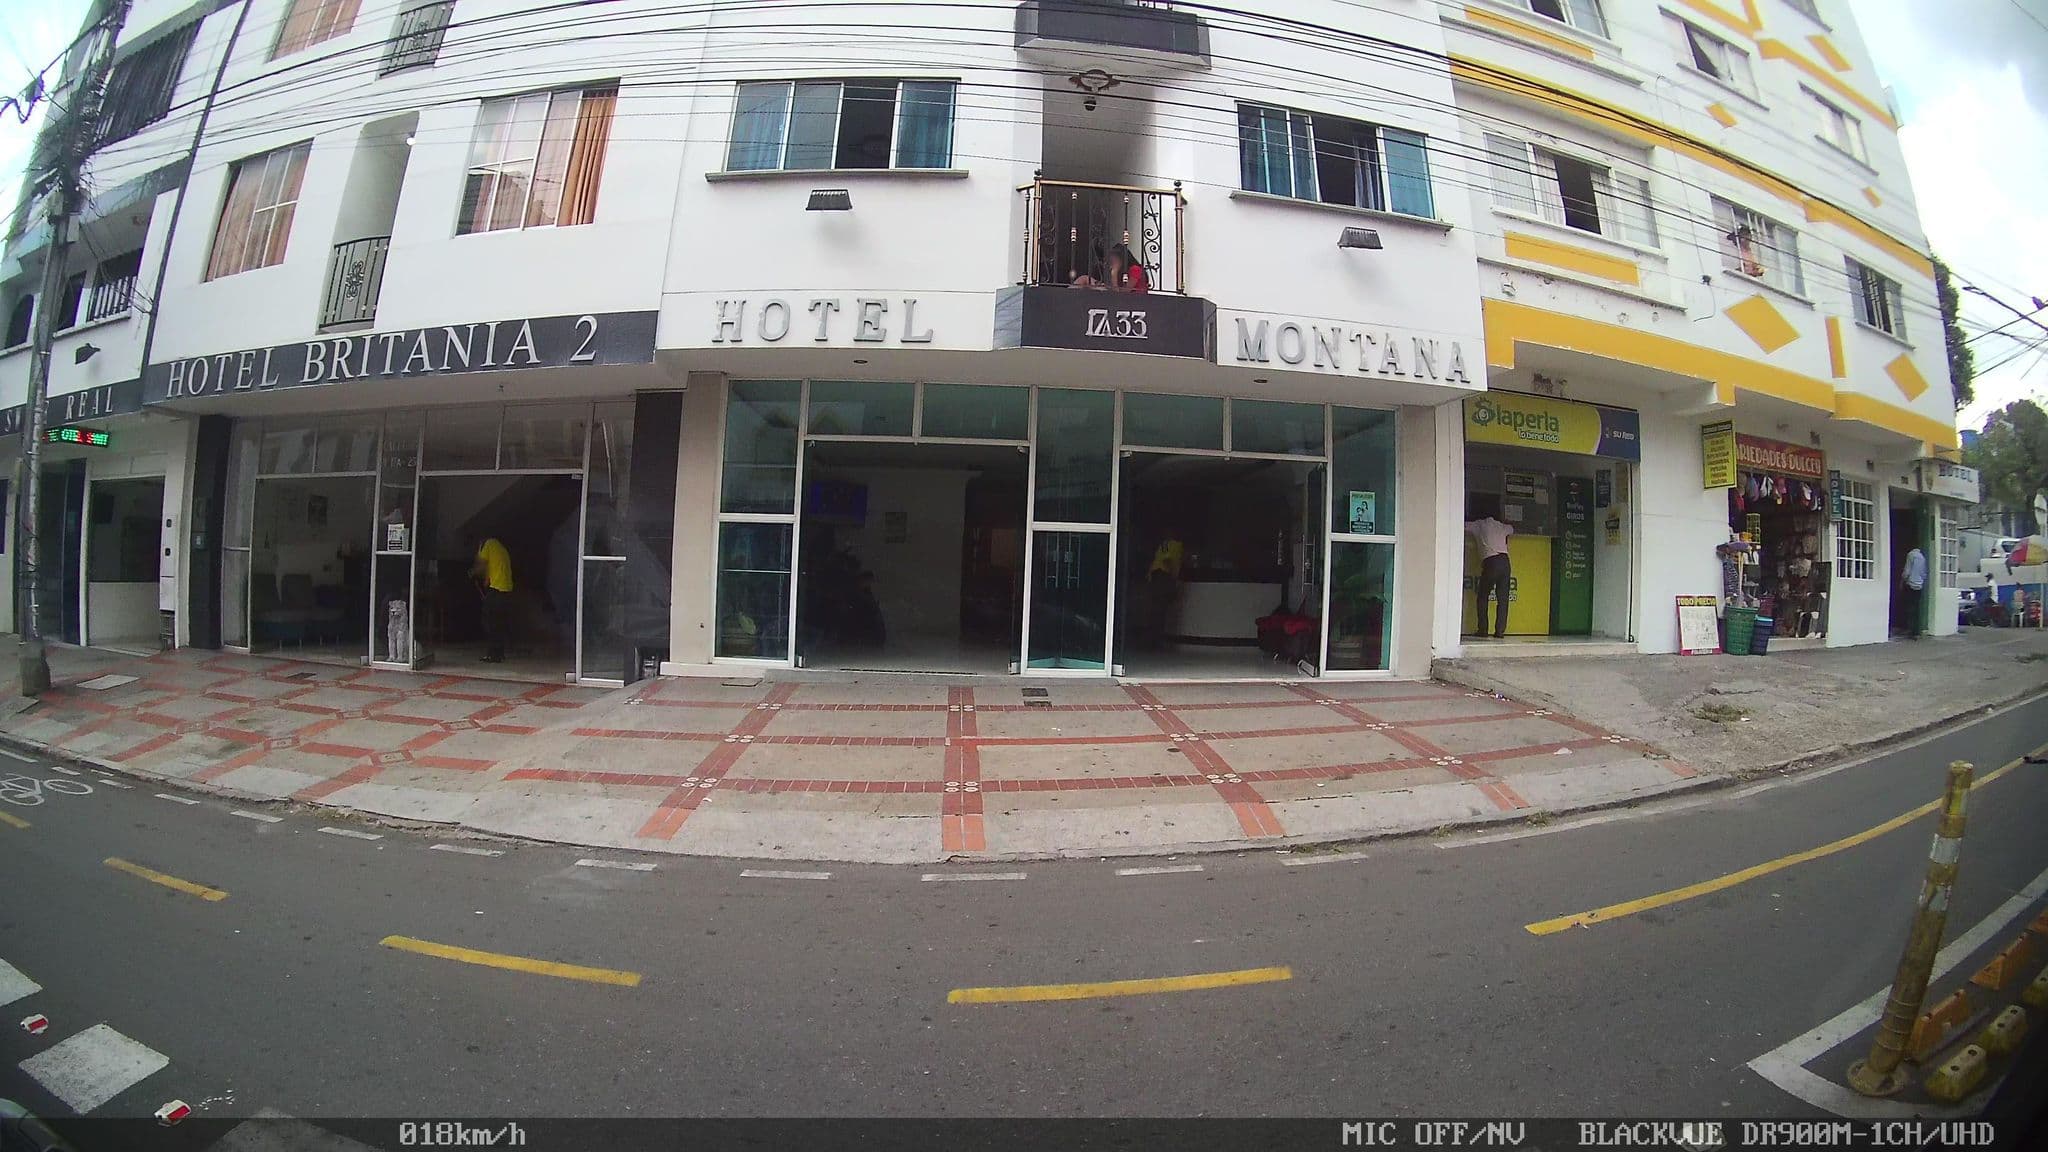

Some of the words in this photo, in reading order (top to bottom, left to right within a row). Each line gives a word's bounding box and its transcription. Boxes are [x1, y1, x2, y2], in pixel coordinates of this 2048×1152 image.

[166, 347, 280, 398] HOTEL
[300, 319, 542, 384] BRITANIA
[568, 315, 598, 362] 2
[712, 298, 934, 343] HOTEL
[1235, 317, 1471, 384] MONTANA
[64, 386, 113, 420] REAL
[1938, 463, 1974, 483] HOTEL
